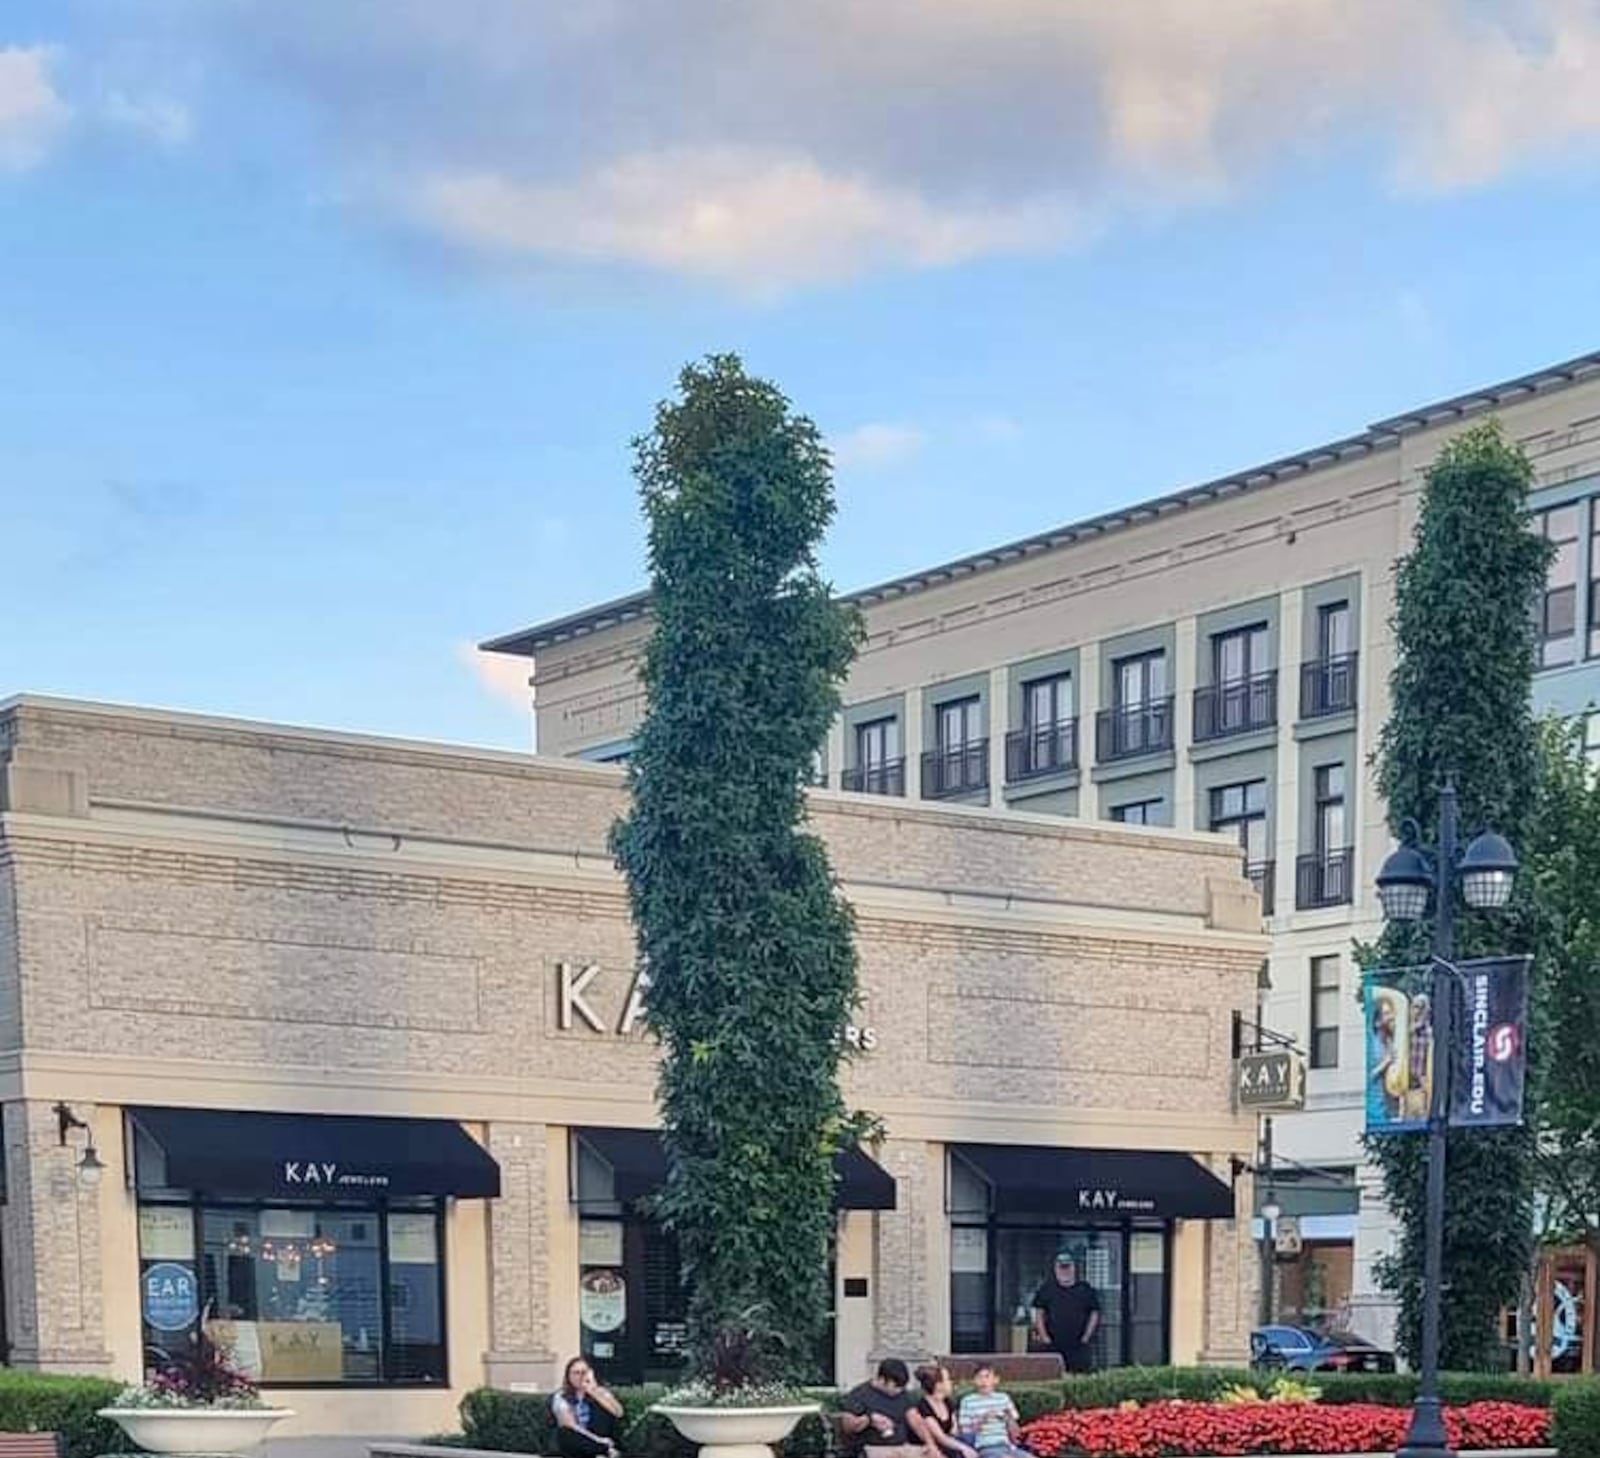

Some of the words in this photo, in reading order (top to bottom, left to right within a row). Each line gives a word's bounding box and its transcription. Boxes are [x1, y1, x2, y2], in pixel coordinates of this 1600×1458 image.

[557, 961, 651, 1034] KA
[1471, 975, 1488, 1114] SINCLAIR.EDU
[1241, 1062, 1288, 1088] KAY
[285, 1162, 336, 1183] KAY
[1079, 1190, 1117, 1209] KAY
[148, 1277, 191, 1297] EAR
